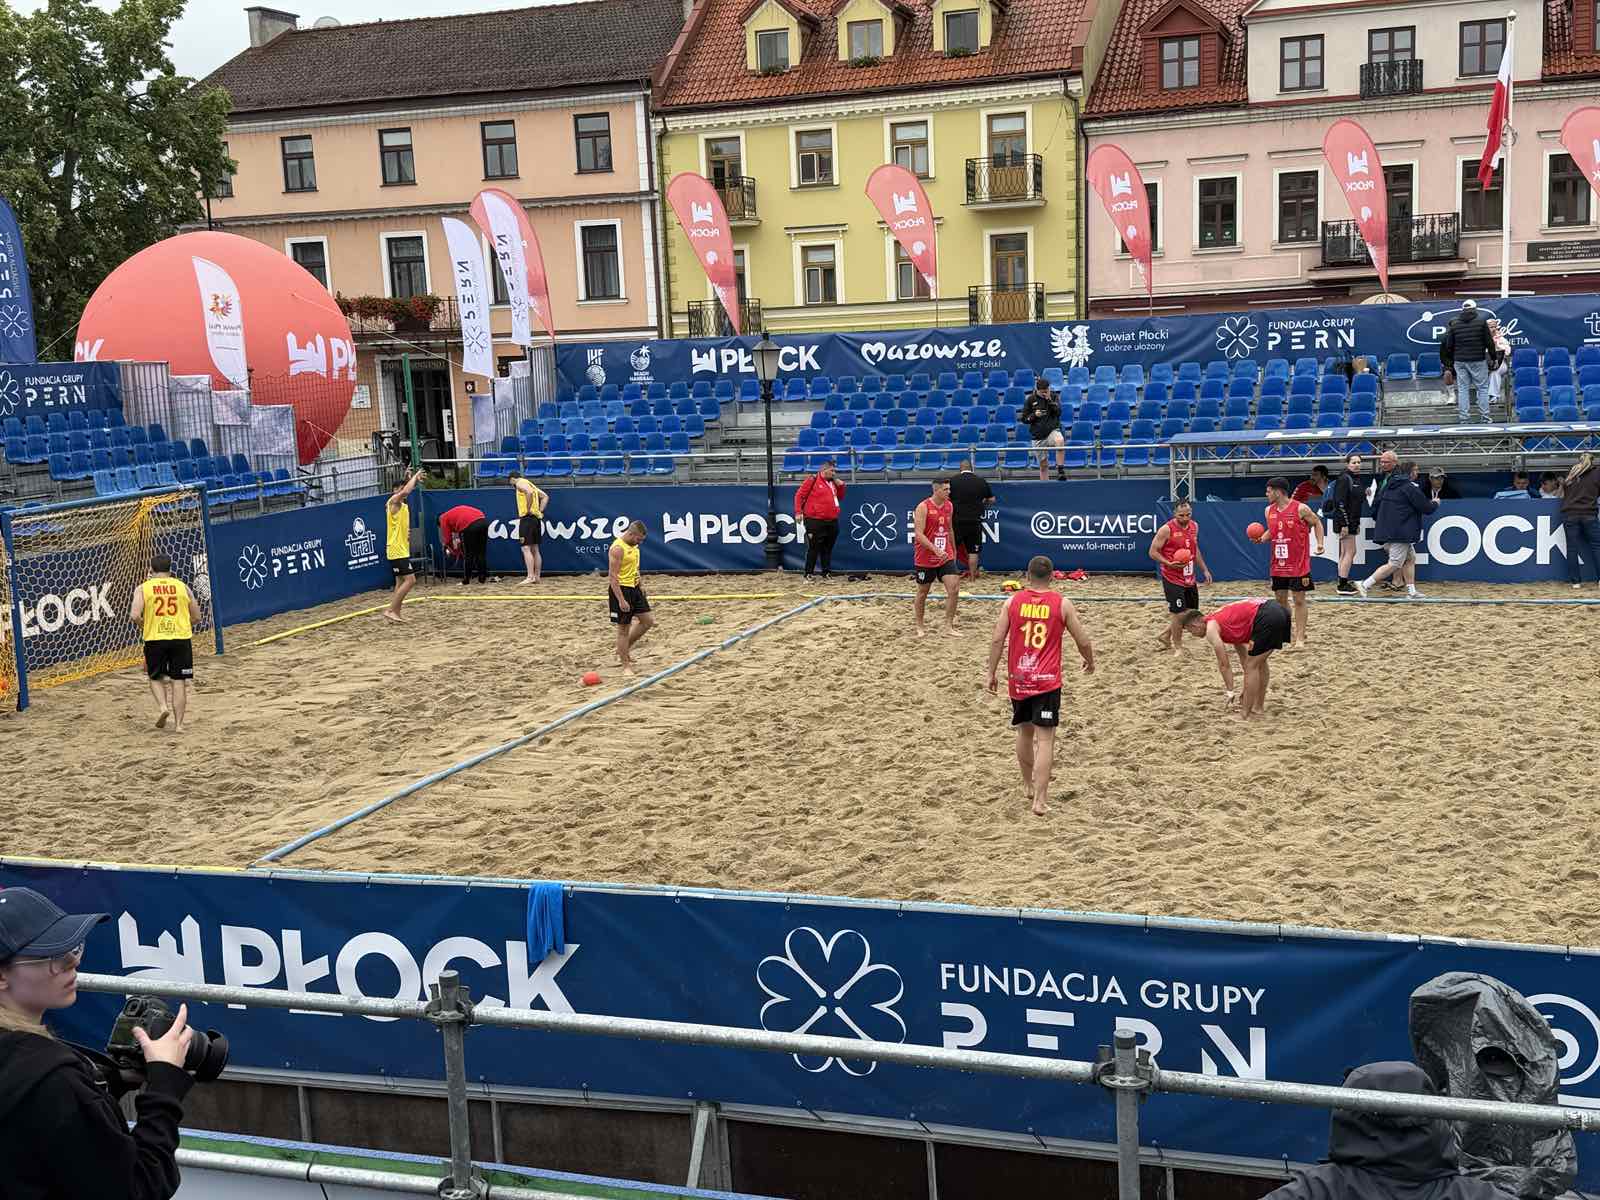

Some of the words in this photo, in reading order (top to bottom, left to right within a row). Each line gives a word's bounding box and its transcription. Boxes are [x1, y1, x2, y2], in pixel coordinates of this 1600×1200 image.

[1268, 319, 1320, 330] FUNDACJA
[1322, 317, 1356, 328] GRUPY
[1100, 330, 1136, 342] Powiat
[1138, 328, 1169, 341] Płocki
[1267, 329, 1356, 351] PERN
[720, 344, 822, 374] PŁCK
[25, 385, 86, 408] PERN
[271, 543, 303, 557] FUNDACJA
[576, 544, 600, 554] serce
[1062, 540, 1136, 552] www.fol-mech.pl
[272, 548, 326, 578] PERN
[153, 585, 177, 595] MKD
[154, 596, 178, 617] 25
[1020, 603, 1051, 619] MKD
[1020, 620, 1048, 650] 18
[220, 924, 580, 1024] PŁOCK
[940, 962, 1128, 1006] FUNDACJA
[1139, 979, 1267, 1016] GRUPY
